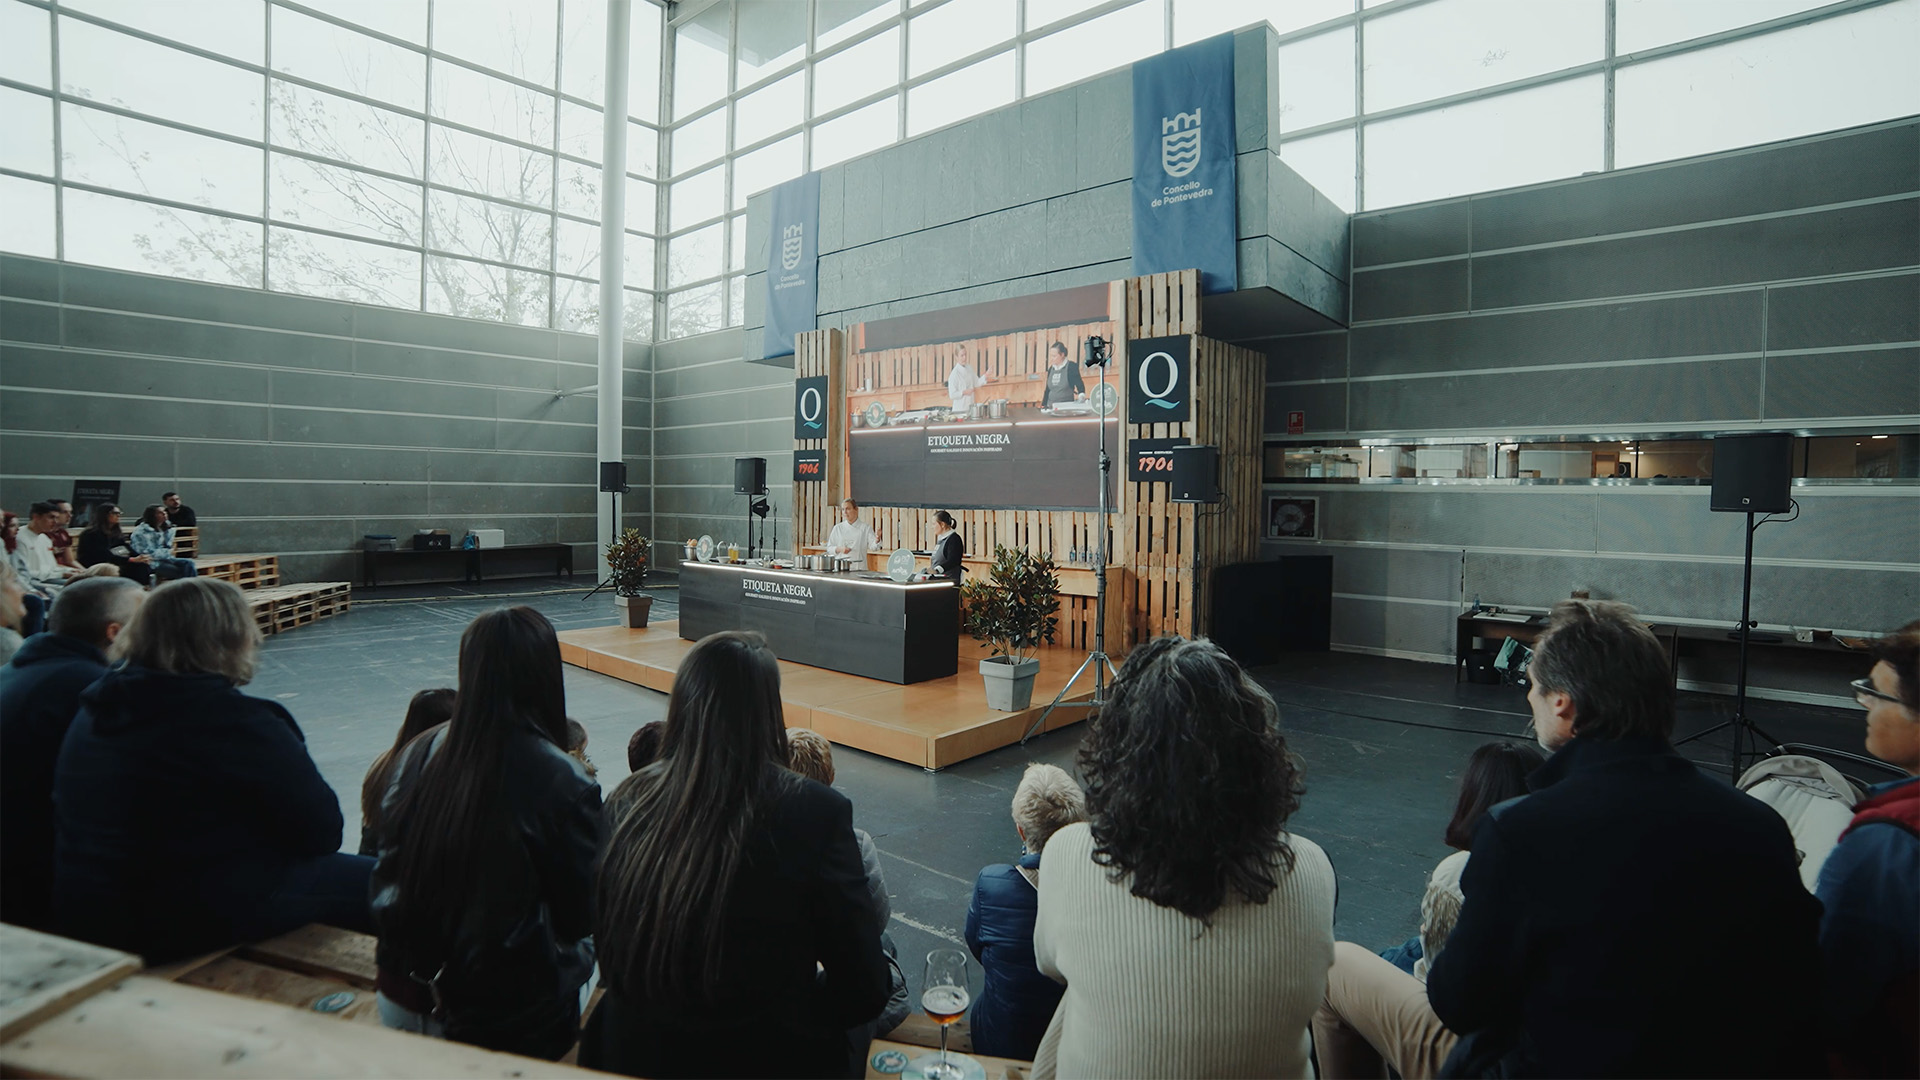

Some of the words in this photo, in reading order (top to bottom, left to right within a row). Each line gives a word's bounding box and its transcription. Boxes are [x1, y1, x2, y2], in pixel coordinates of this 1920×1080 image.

[1162, 181, 1201, 195] Concello
[1151, 198, 1163, 208] de
[1163, 188, 1214, 205] Pontevedra
[780, 273, 800, 282] Concello
[780, 279, 806, 289] Pontevedra
[1138, 352, 1180, 410] Q
[800, 387, 822, 430] Q
[927, 435, 973, 447] ETIQUETA
[975, 434, 1011, 445] NEGRA
[798, 463, 820, 474] 1906
[1138, 456, 1174, 473] 1906
[742, 579, 781, 594] ETIQUETA
[783, 584, 813, 598] NEGRA
